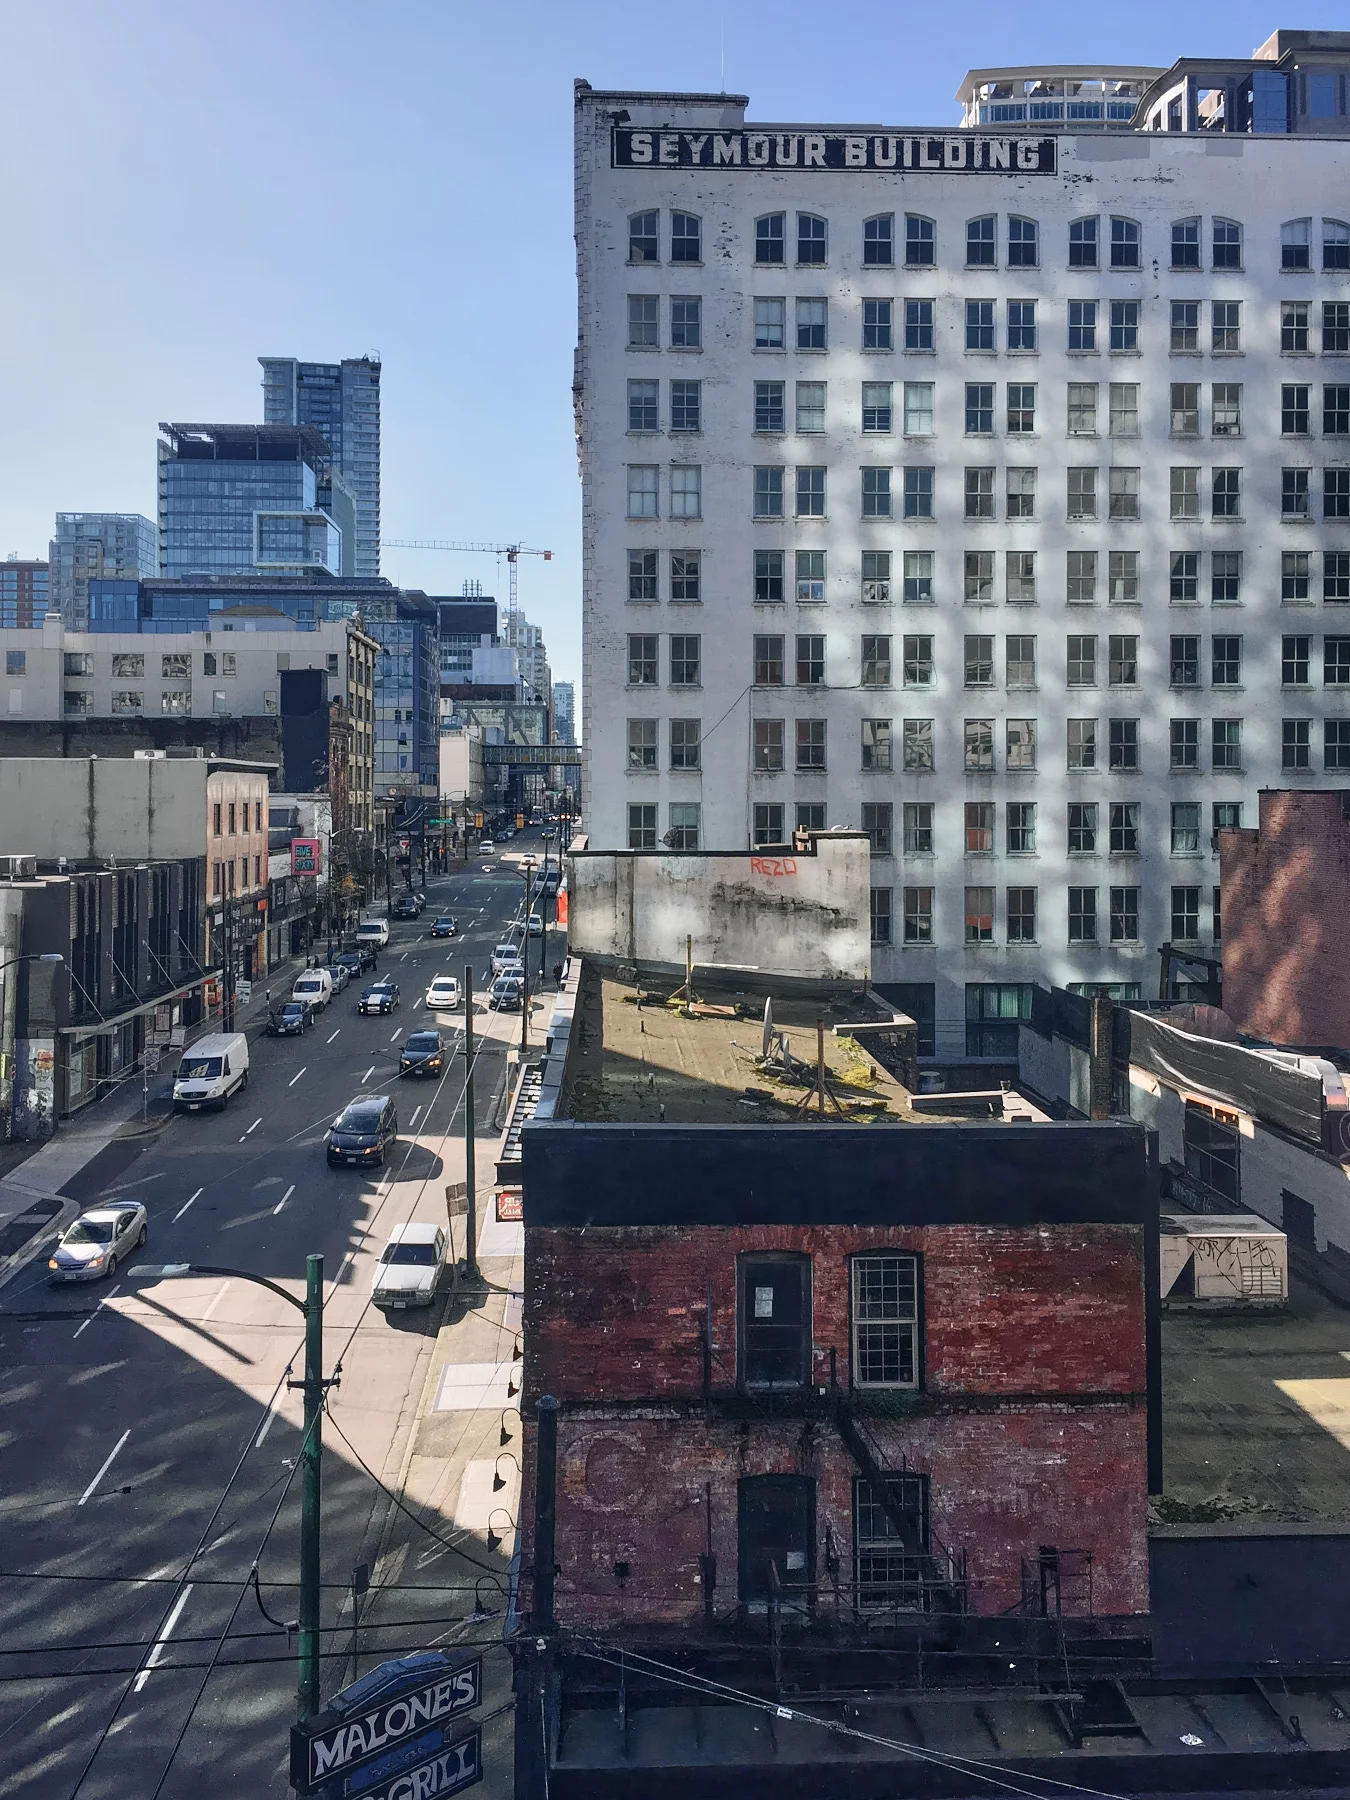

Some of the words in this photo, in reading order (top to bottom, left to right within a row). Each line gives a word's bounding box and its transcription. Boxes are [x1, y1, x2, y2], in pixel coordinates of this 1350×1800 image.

[630, 134, 826, 168] SEYMOUR
[845, 137, 1040, 170] BUILDING
[313, 1671, 475, 1777] MALONE'S
[388, 1743, 475, 1800] GRILL
